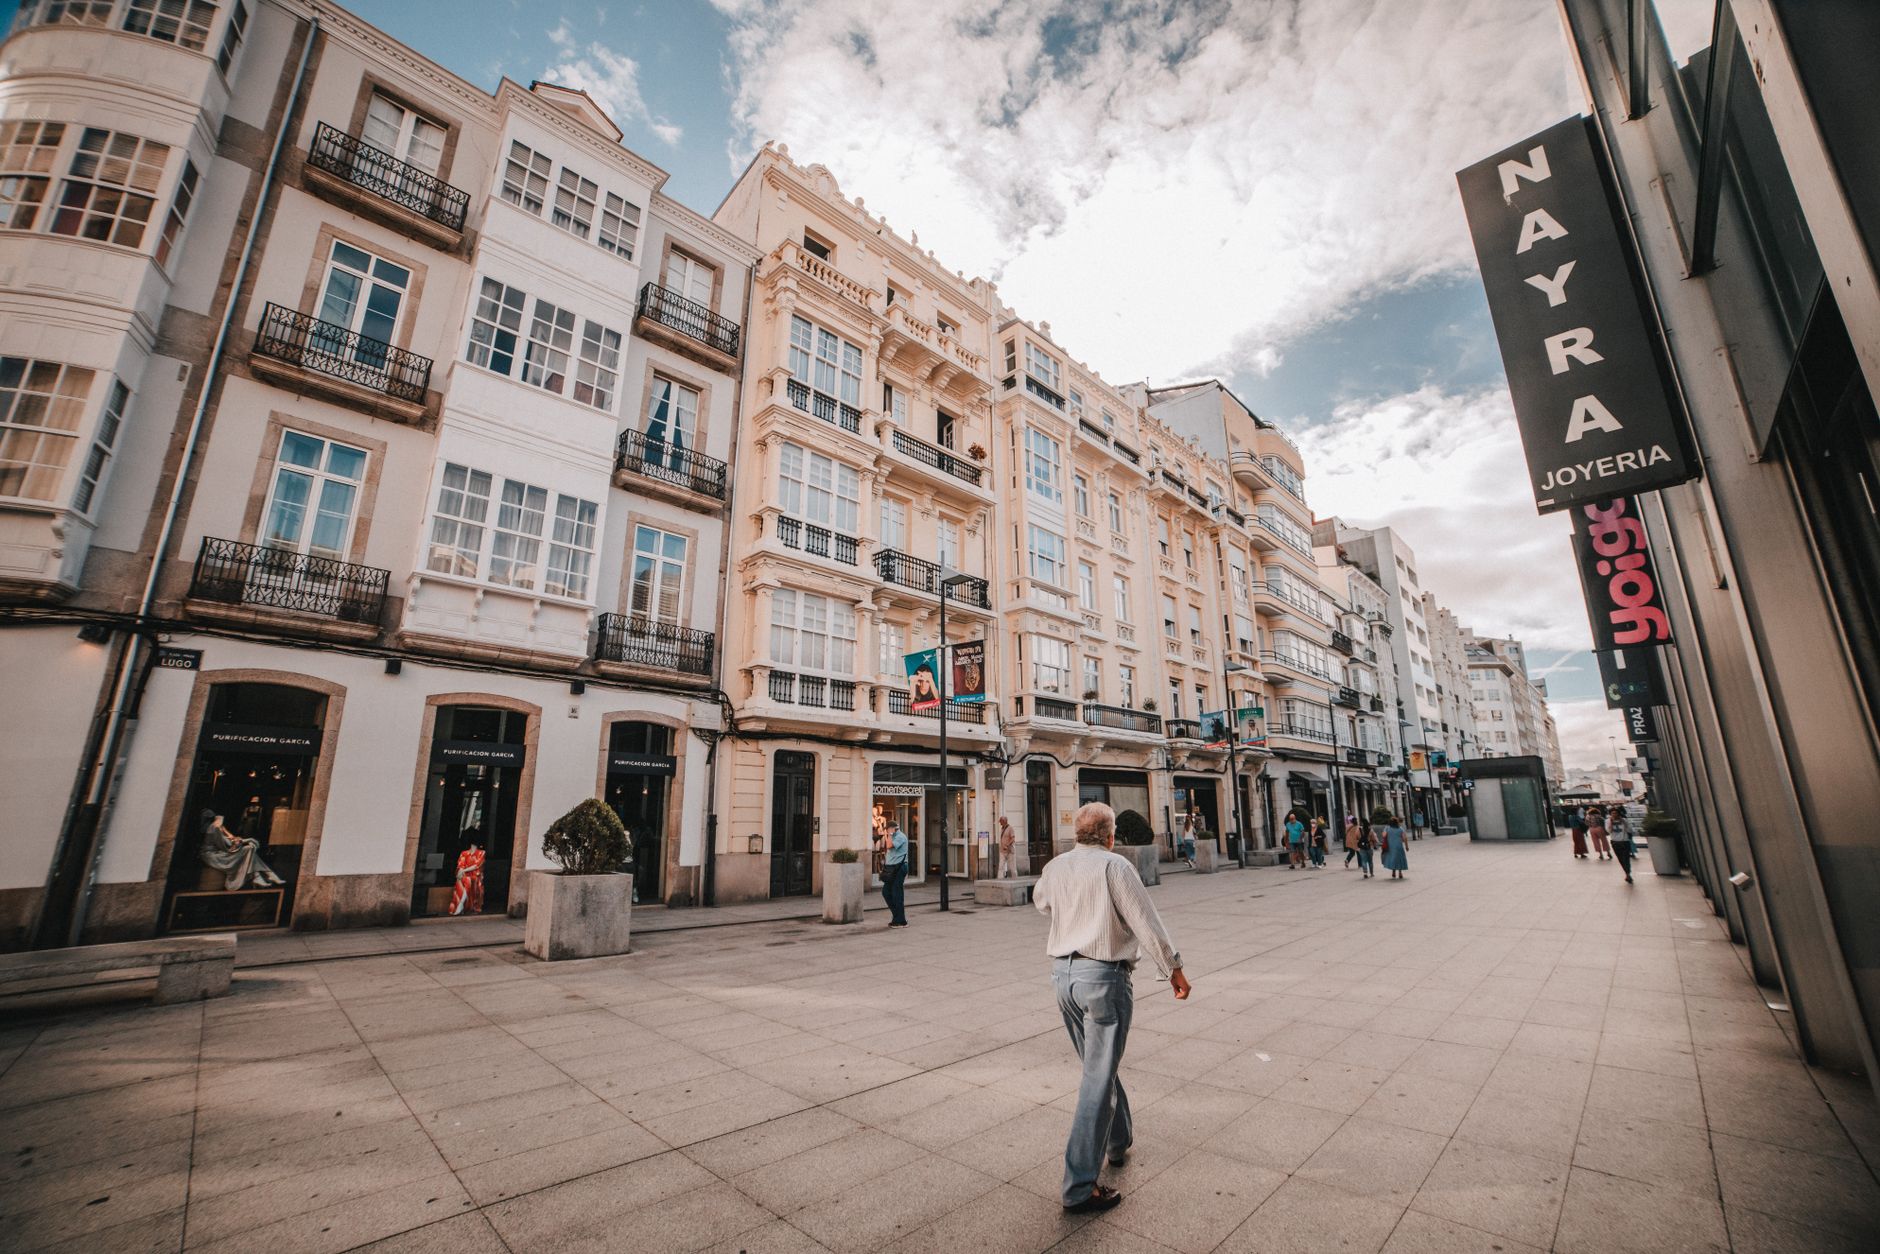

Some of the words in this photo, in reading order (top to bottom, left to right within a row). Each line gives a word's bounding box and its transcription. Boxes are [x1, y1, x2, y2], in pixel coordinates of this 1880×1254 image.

[1498, 144, 1623, 443] NAYRA
[1541, 445, 1672, 491] JOYERIA
[161, 658, 192, 668] LUGO
[213, 734, 277, 743] PURIFICACION
[444, 749, 490, 757] PURIFICACION
[614, 759, 651, 767] PURIFICACION
